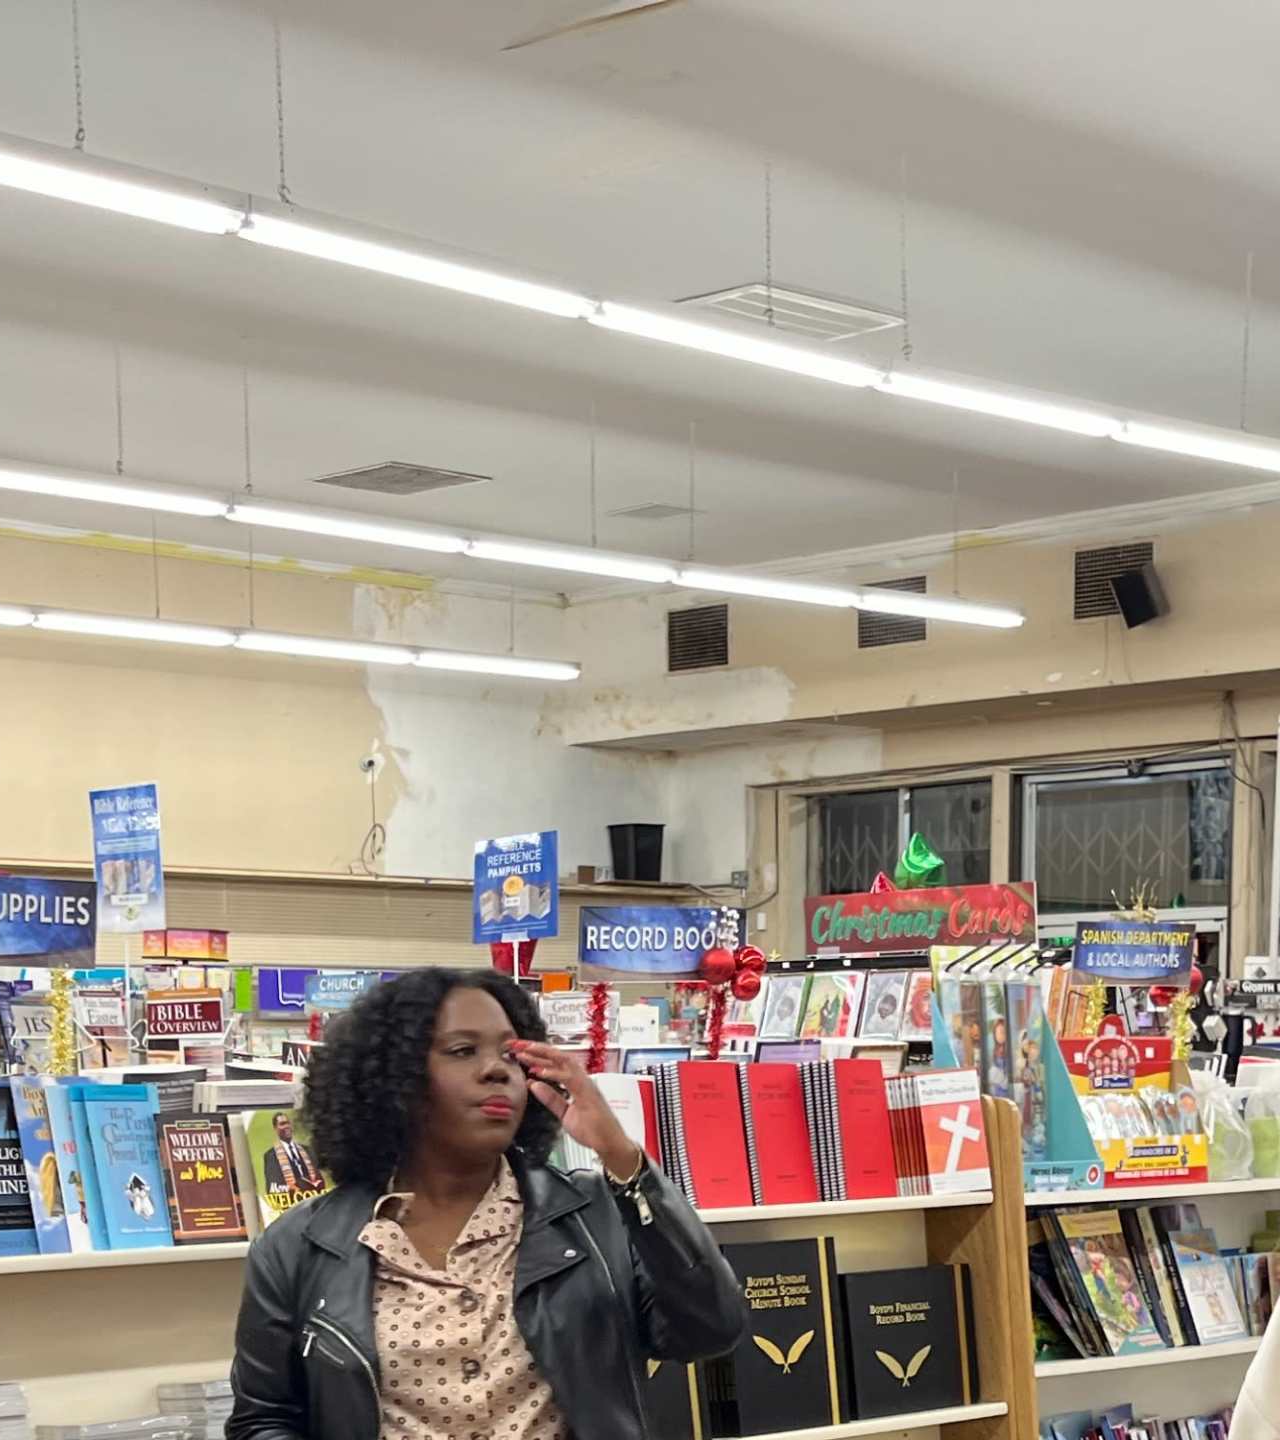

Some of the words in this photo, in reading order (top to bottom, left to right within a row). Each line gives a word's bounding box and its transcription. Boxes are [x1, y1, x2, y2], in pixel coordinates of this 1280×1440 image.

[487, 849, 542, 866] REFERENCE
[488, 862, 542, 879] PAMPHLETS
[811, 900, 944, 945] Christmas
[948, 889, 1028, 937] Cards
[586, 925, 668, 951] RECORD
[1081, 929, 1125, 946] SPANISH
[1127, 931, 1190, 947] DEPARTMENT
[1096, 952, 1131, 968] LOCAL
[1131, 953, 1181, 969] AUTHORS
[320, 977, 365, 993] CHURCH
[157, 1003, 203, 1020] BIBLE
[170, 1131, 224, 1148] WELCOME
[172, 1148, 224, 1162] SPEECHES
[195, 1160, 224, 1183] More
[776, 1274, 807, 1286] SUNDAY
[745, 1288, 778, 1299] CHURCH
[780, 1285, 812, 1297] SCHOOL
[751, 1298, 782, 1310] MINUTE
[784, 1296, 807, 1308] BOOK
[876, 1313, 905, 1325] RECORD
[906, 1311, 927, 1323] BOOK
